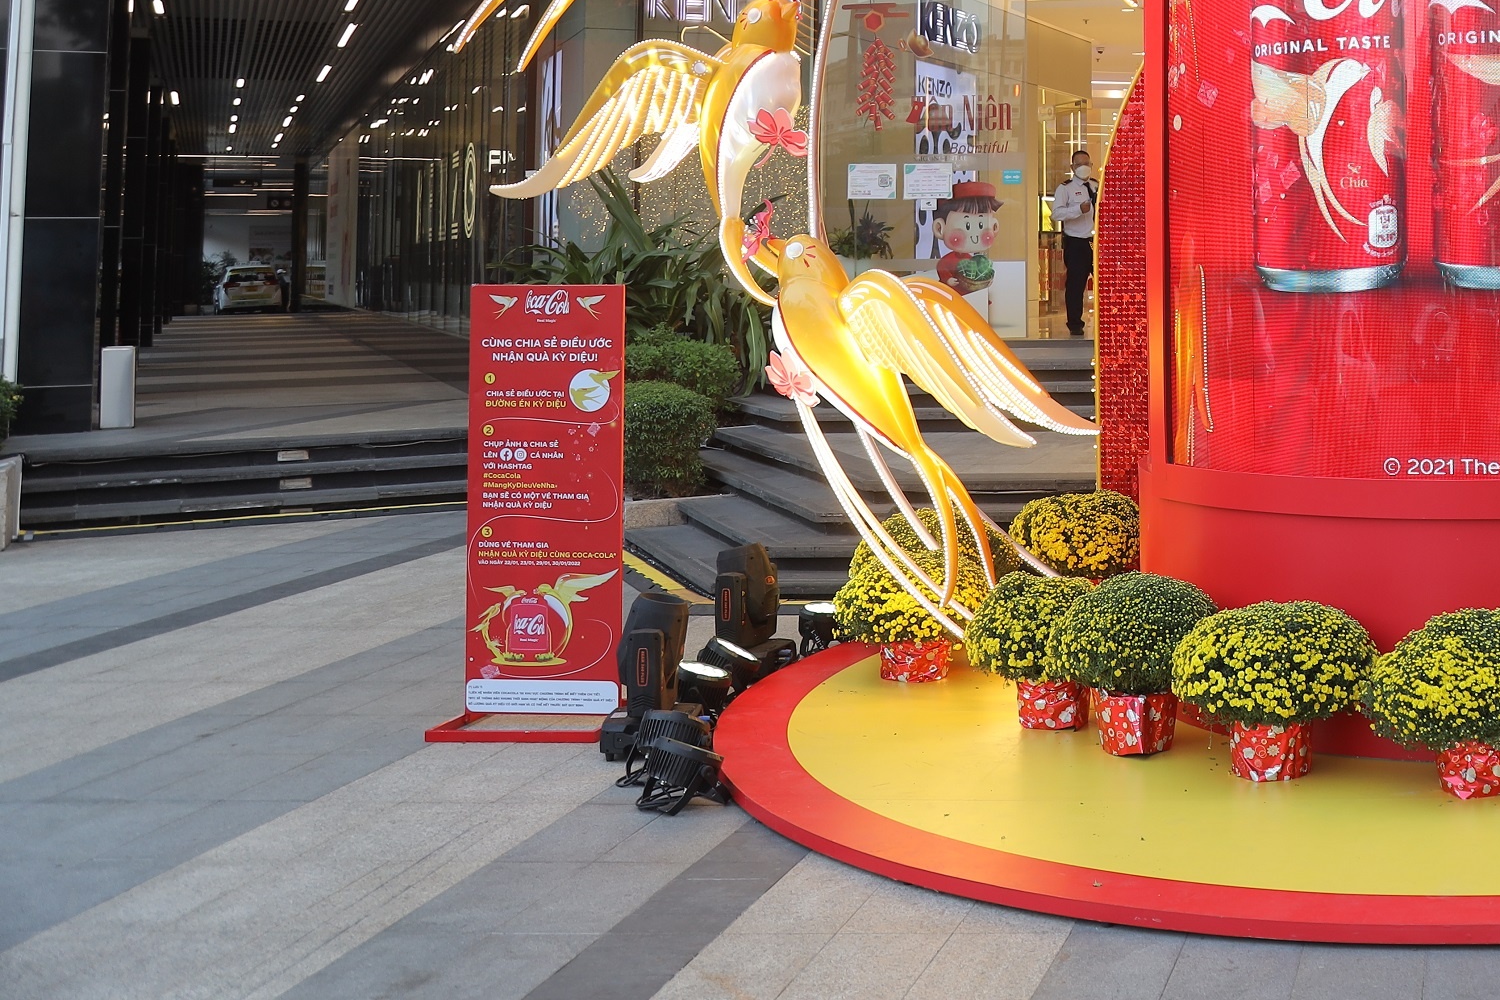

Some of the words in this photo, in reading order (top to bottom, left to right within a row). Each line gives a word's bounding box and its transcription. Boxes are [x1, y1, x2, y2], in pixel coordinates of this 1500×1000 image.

[1255, 39, 1328, 57] ORIGINAL
[1336, 36, 1391, 50] TASTE
[918, 75, 952, 98] KENZO
[962, 95, 1012, 131] Niên
[950, 141, 1008, 153] Bountiful
[482, 337, 512, 347] CÙNG
[515, 339, 541, 347] CHIA
[544, 336, 557, 347] SẺ
[589, 337, 612, 348] ƯỚC
[492, 351, 523, 363] NHẬN
[527, 351, 549, 362] QUÀ
[552, 351, 566, 361] KỲ
[569, 351, 597, 363] DIỆU!
[506, 389, 515, 397] SẺ
[485, 399, 516, 407] ĐƯỜNG
[519, 399, 530, 407] ÉN
[546, 399, 566, 409] DIỆU
[505, 439, 521, 447] ẢNH
[1408, 459, 1455, 475] 2021
[1461, 458, 1500, 474] The
[524, 492, 540, 500] MỘT
[483, 501, 504, 509] NHẬN
[535, 501, 552, 509] DIỆU
[478, 550, 500, 559] NHẬN
[502, 550, 517, 558] QUÀ
[531, 550, 548, 559] DIỆU
